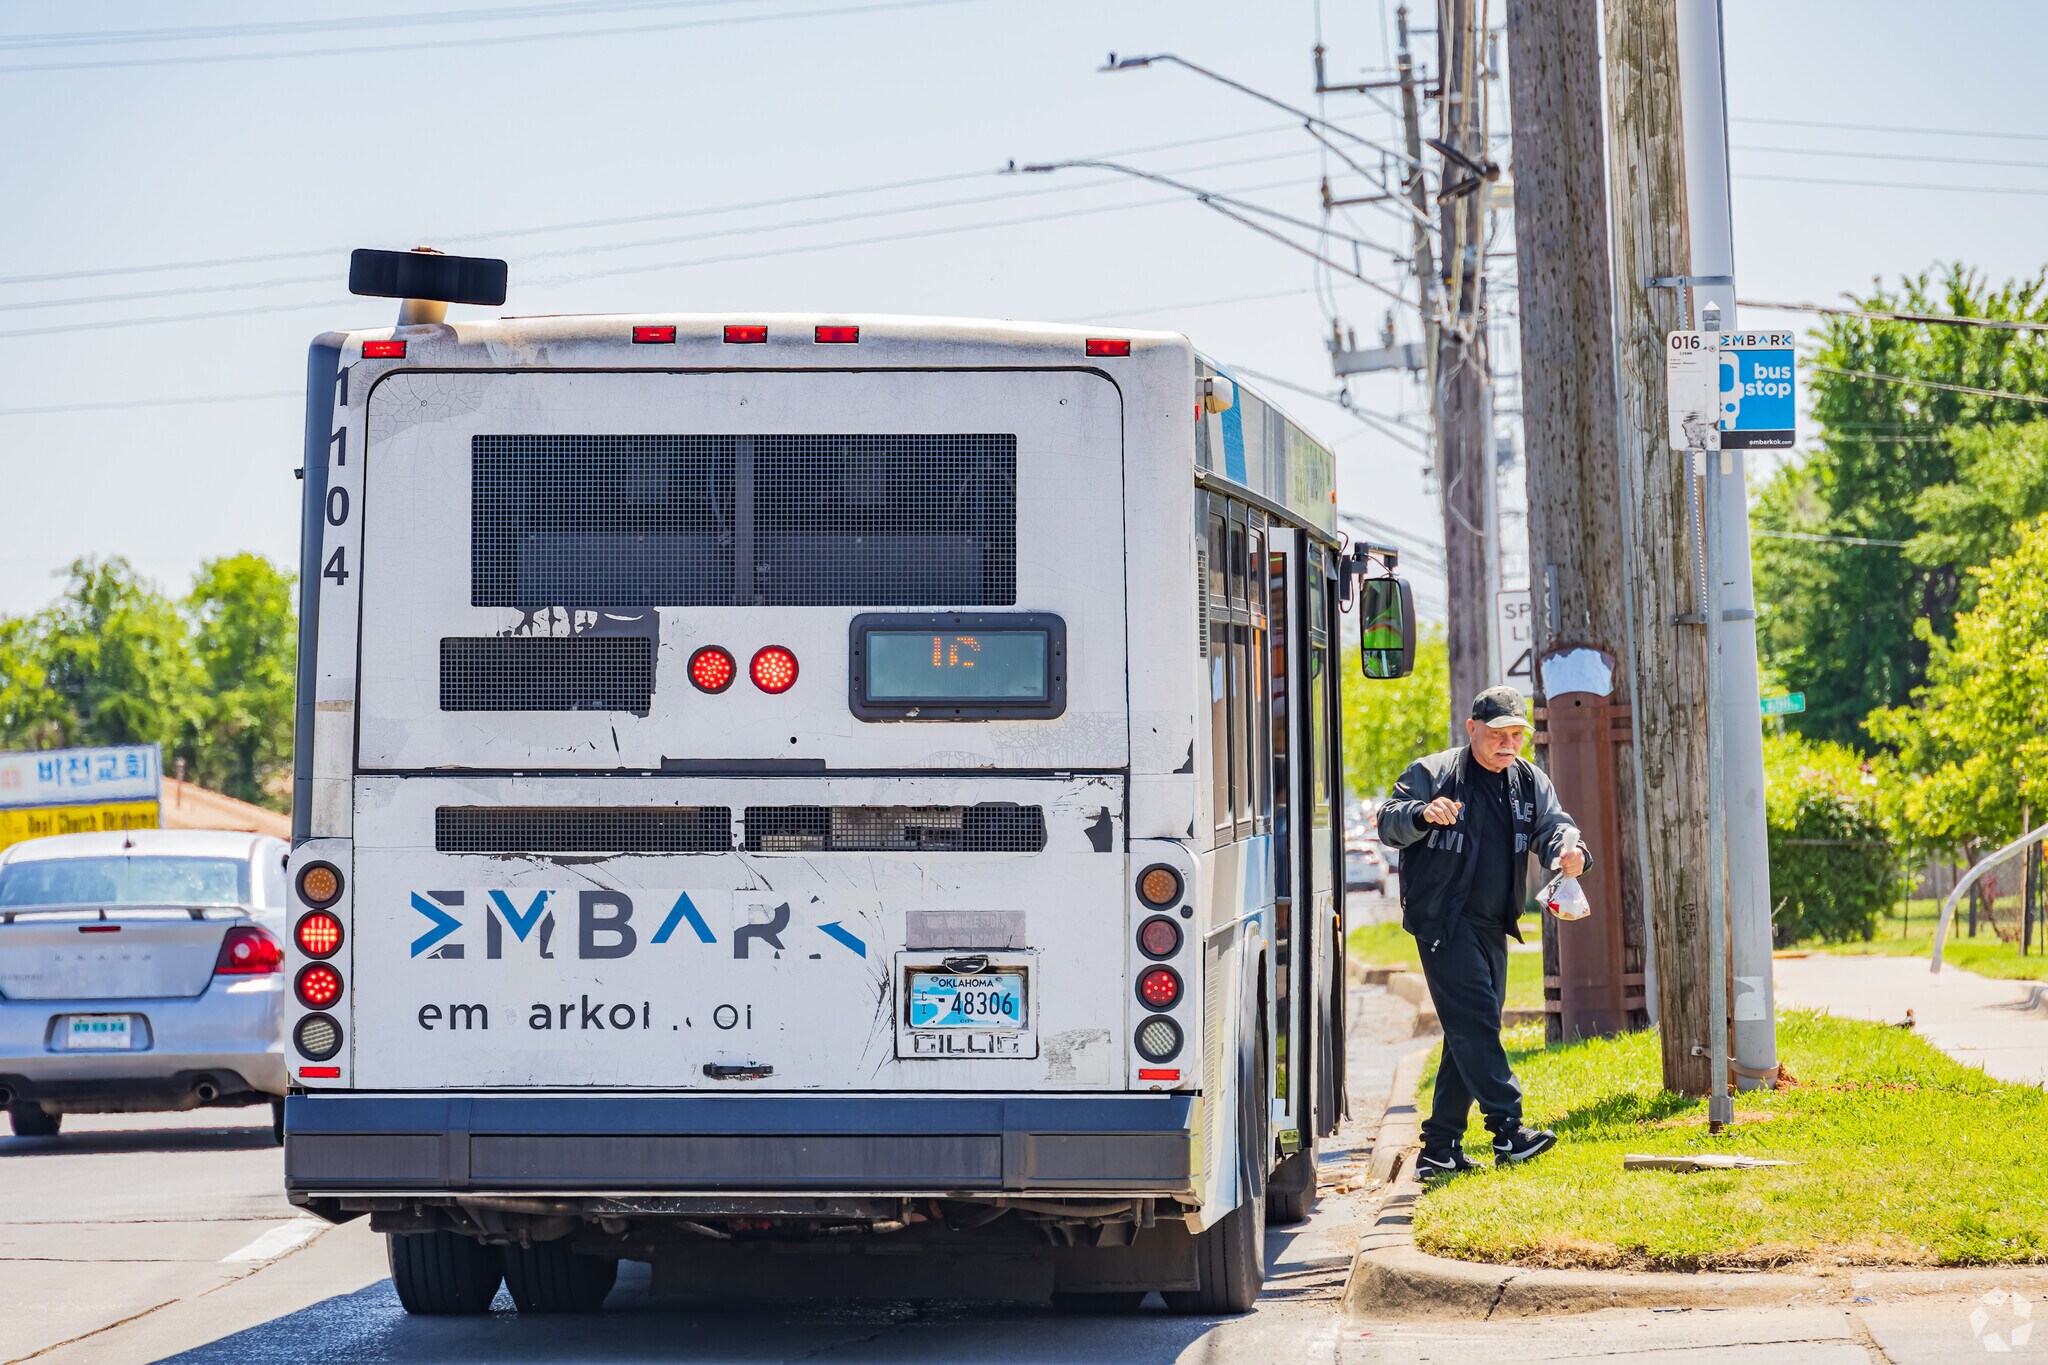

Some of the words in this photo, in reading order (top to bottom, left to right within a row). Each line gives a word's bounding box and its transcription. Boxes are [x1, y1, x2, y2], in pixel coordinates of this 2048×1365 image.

[1671, 336, 1700, 349] 016
[1720, 335, 1792, 346] EMBARK
[1754, 363, 1791, 379] bus
[1745, 381, 1792, 398] stop
[323, 366, 350, 586] 1104
[1505, 603, 1532, 619] SP
[1507, 648, 1533, 682] 4
[938, 978, 994, 988] OKLAHOMA
[951, 992, 1013, 1015] 48306
